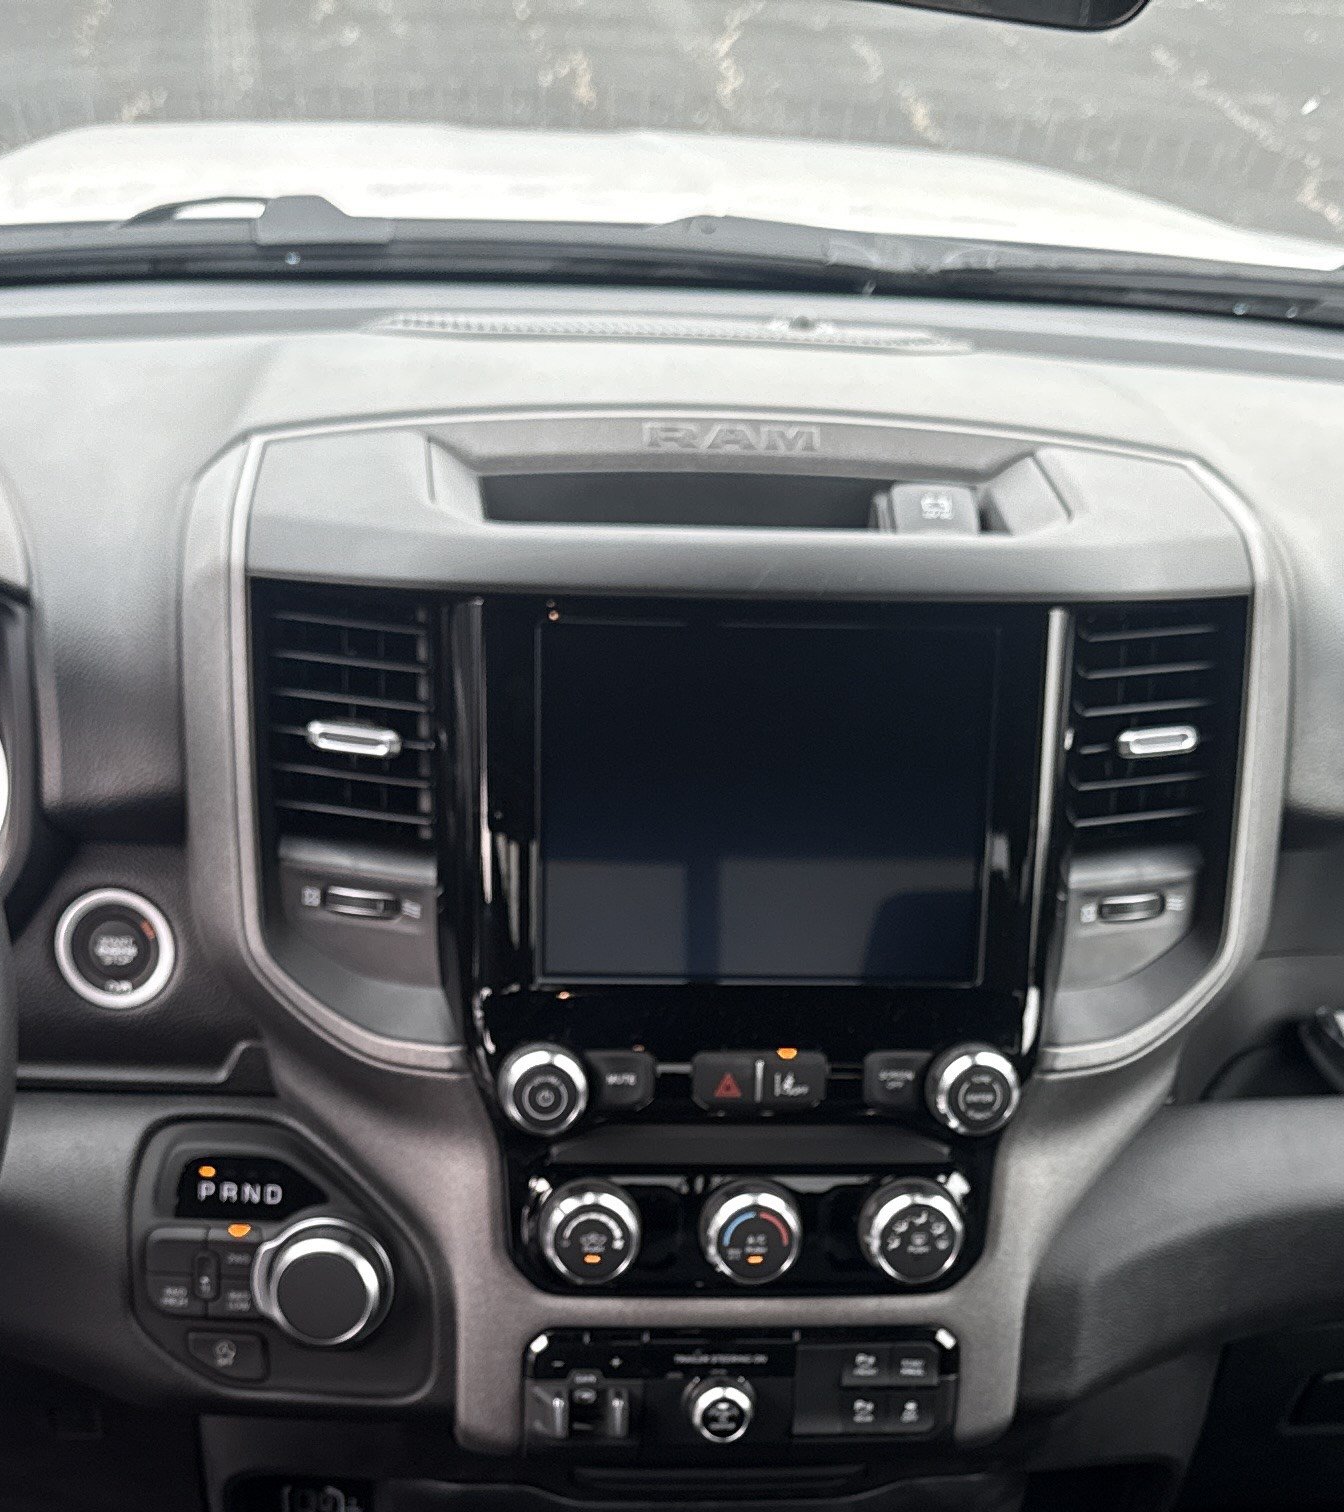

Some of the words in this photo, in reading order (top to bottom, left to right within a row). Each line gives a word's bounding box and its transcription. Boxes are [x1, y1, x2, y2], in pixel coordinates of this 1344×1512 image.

[642, 421, 821, 453] RAM
[197, 1180, 216, 1201] P
[219, 1181, 240, 1204] R
[242, 1182, 261, 1205] N
[263, 1183, 283, 1205] D
